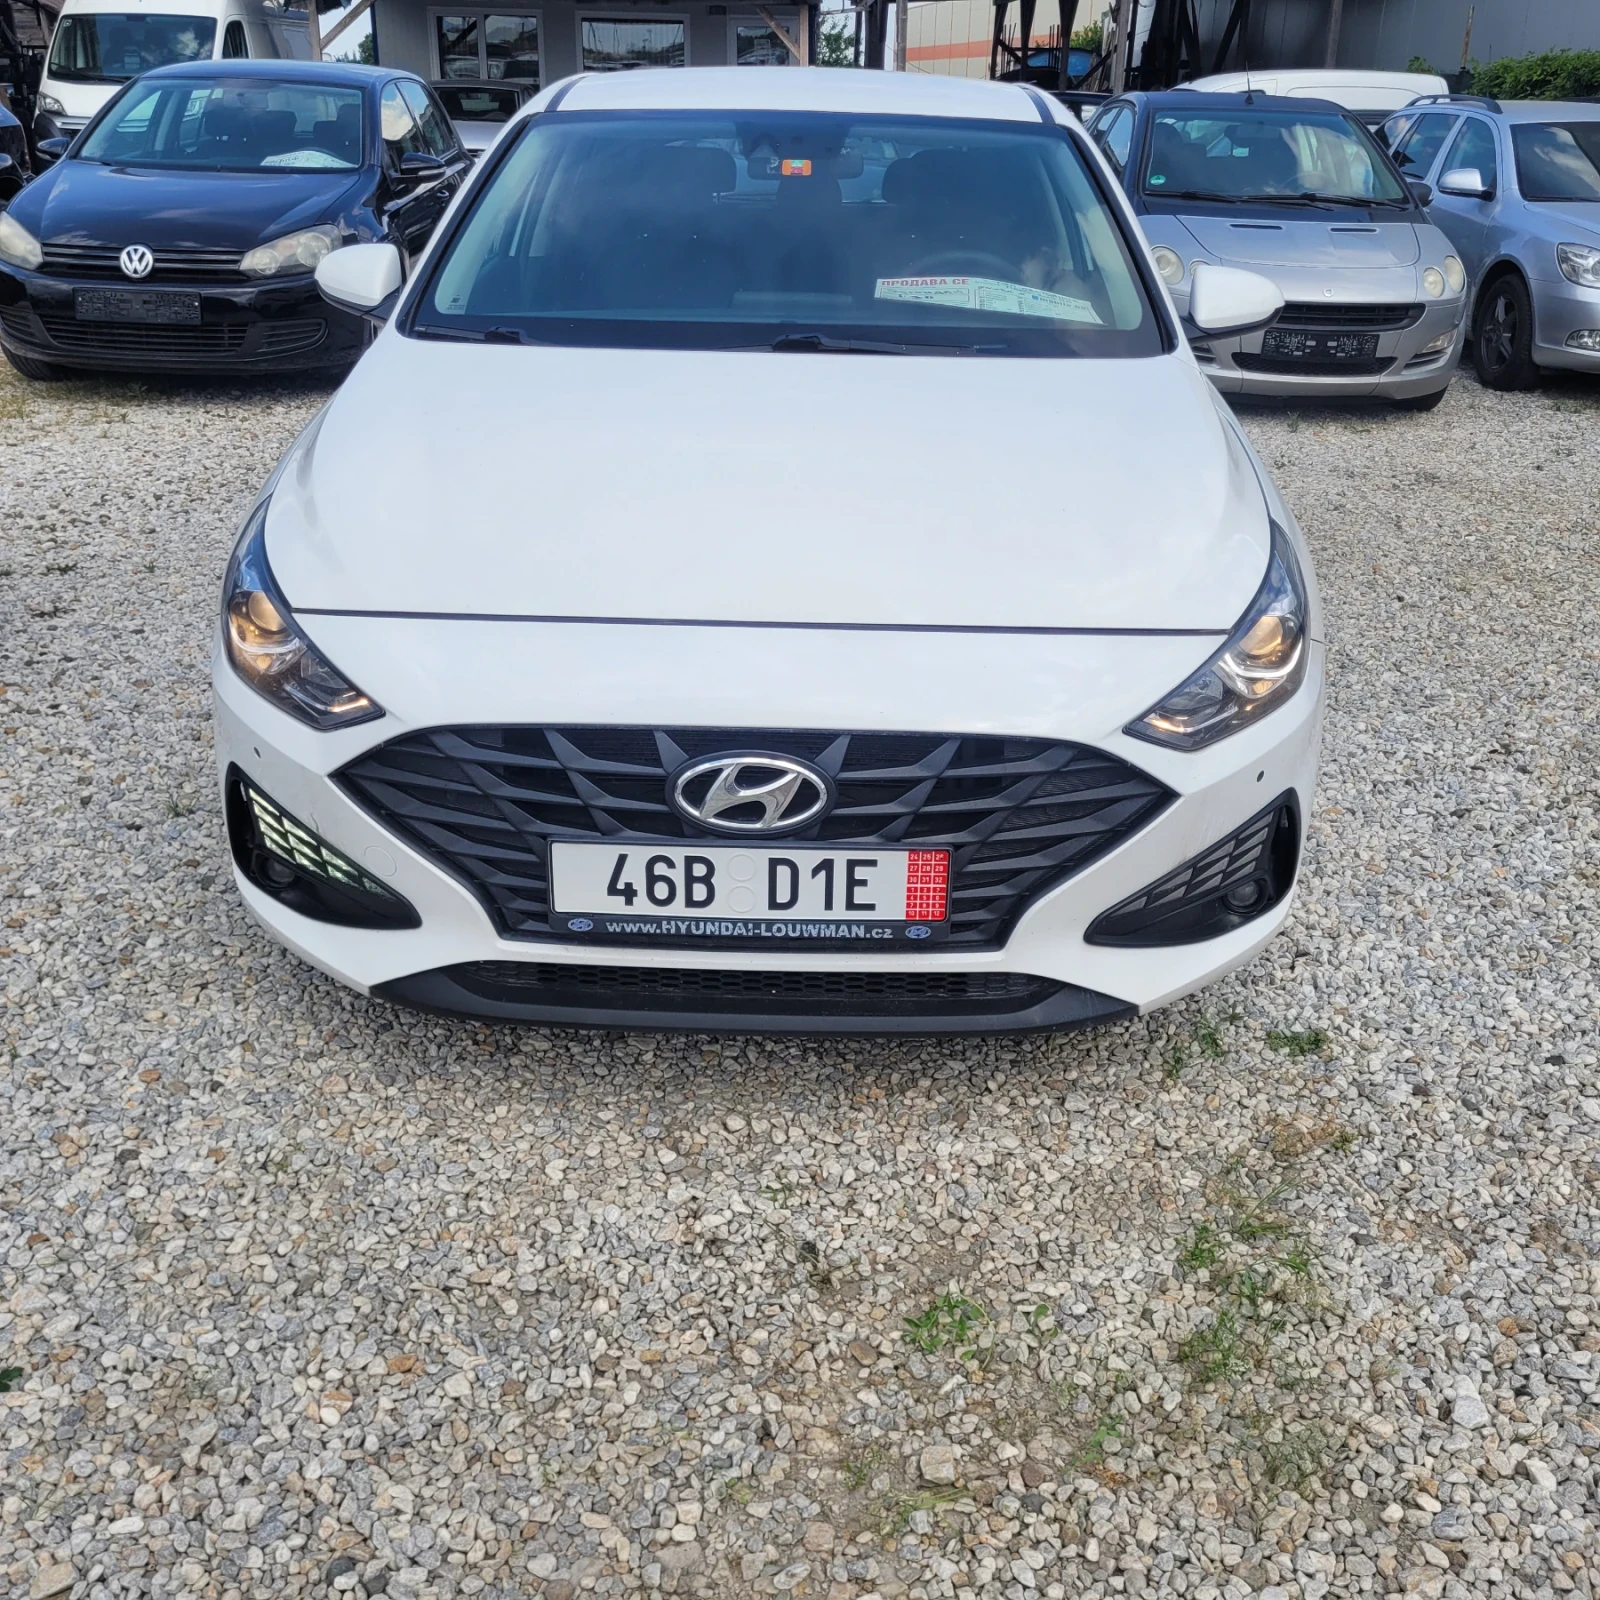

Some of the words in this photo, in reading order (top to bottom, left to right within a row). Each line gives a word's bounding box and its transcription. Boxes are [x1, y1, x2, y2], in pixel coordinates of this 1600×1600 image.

[881, 278, 948, 287] ПРОДАВА
[952, 278, 970, 286] СЕ
[910, 853, 918, 861] 24
[607, 853, 716, 909] 46B
[768, 857, 878, 911] D1E
[605, 919, 893, 939] www.HYUNDAI-LOUWMAN.cz
